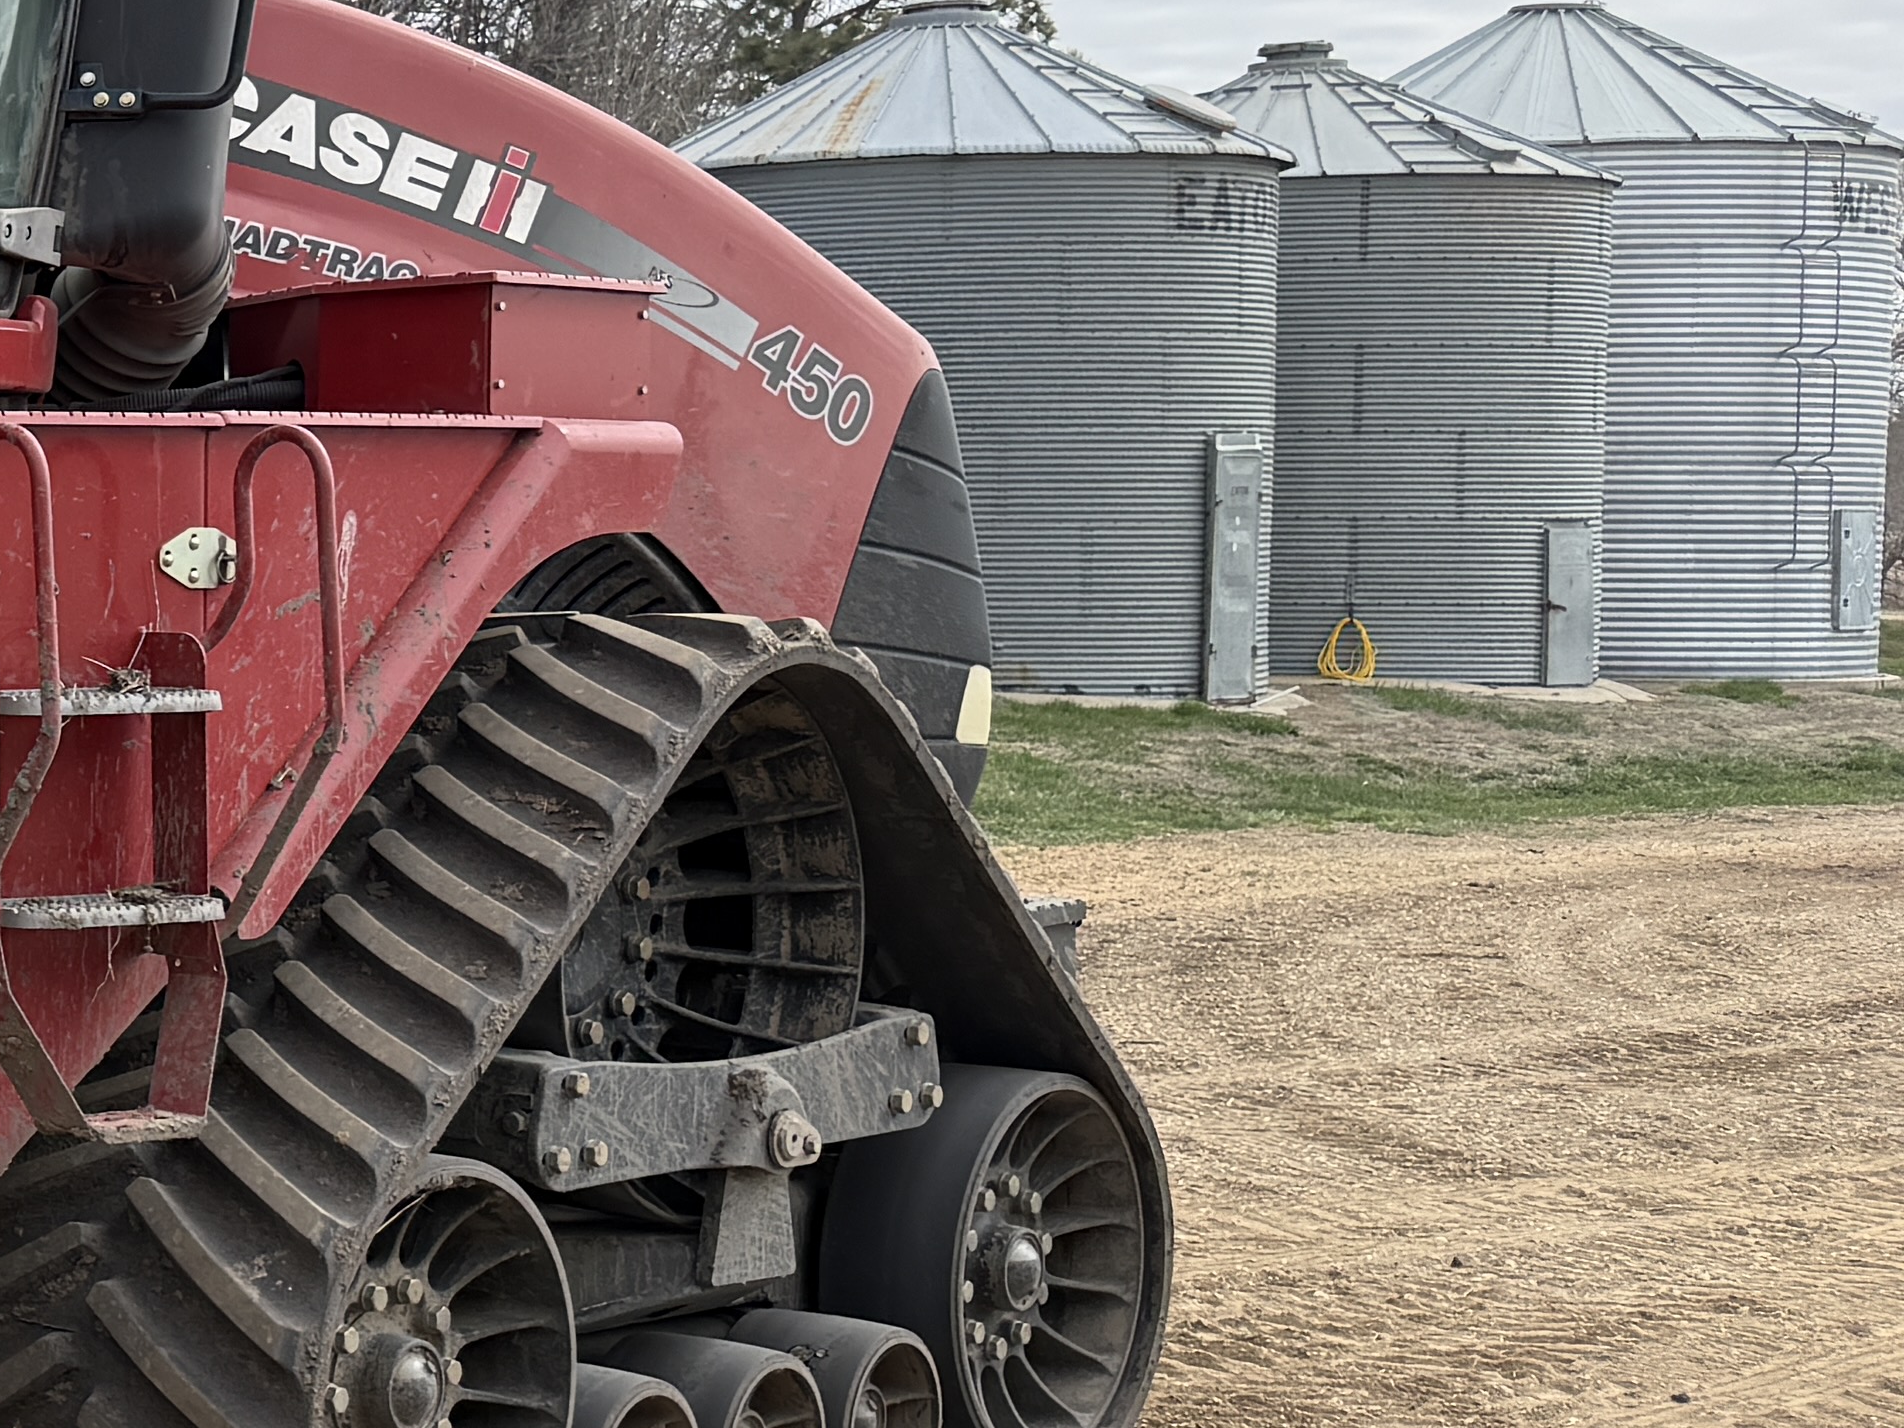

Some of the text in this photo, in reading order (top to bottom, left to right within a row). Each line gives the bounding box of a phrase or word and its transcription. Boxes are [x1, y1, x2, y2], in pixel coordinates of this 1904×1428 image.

[224, 215, 422, 282] ADTRA
[647, 265, 673, 289] AFS
[747, 324, 874, 447] 450
